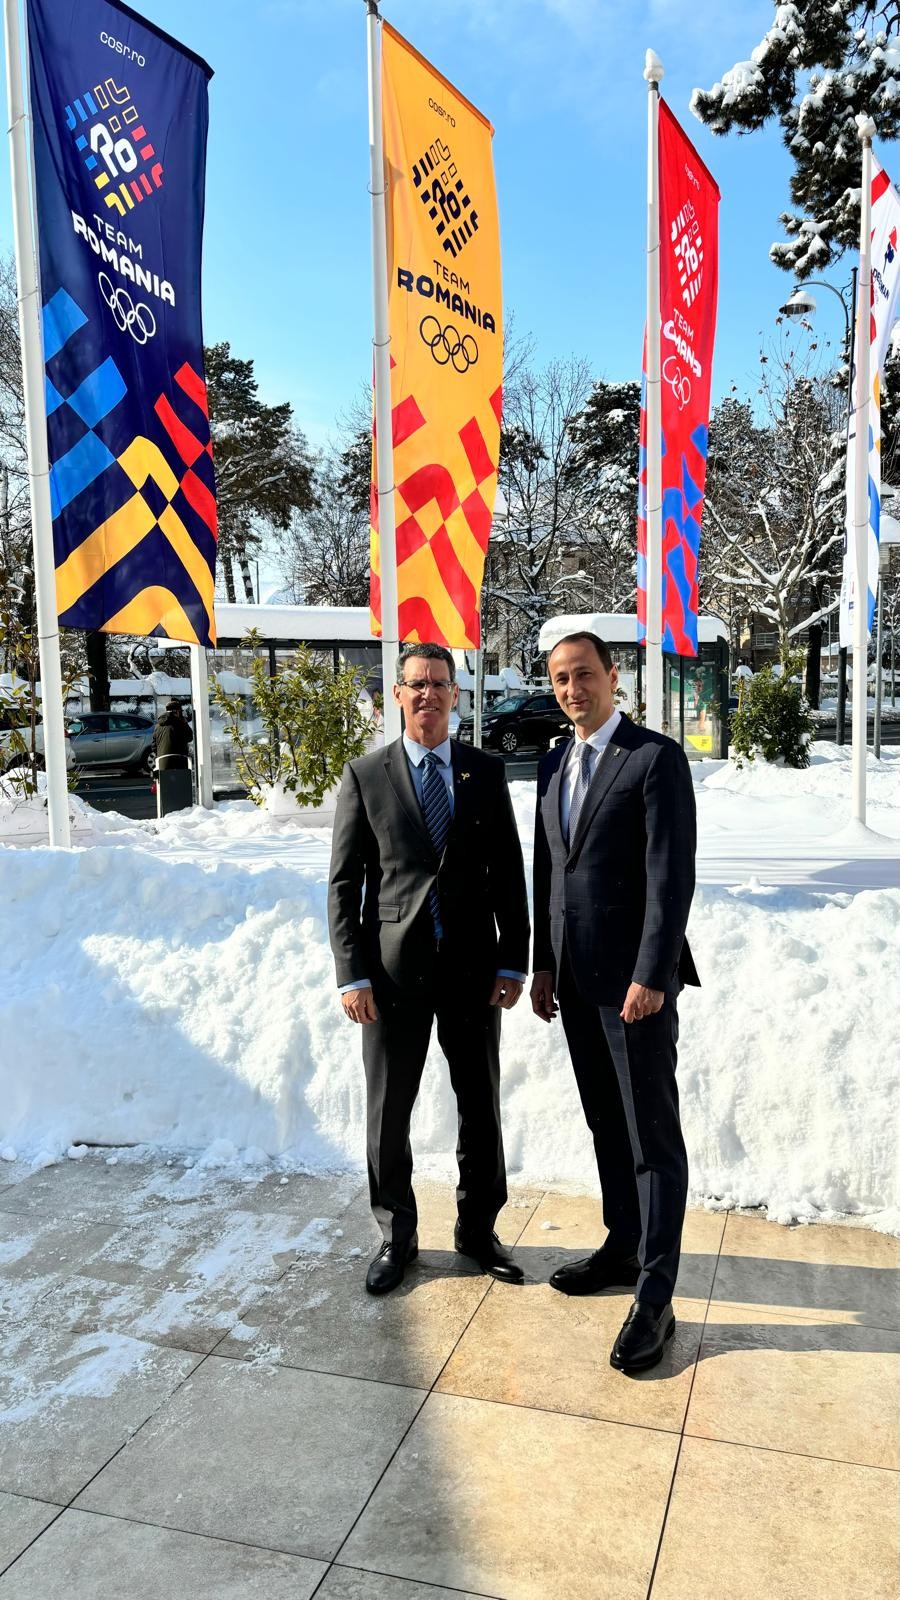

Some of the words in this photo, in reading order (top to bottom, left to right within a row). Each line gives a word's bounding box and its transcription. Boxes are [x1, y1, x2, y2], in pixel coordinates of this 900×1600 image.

[99, 31, 146, 67] cosr.ro
[428, 97, 456, 128] cosr.ro
[93, 214, 143, 259] TEAM
[71, 210, 176, 307] ROMANIA
[433, 259, 470, 294] TEAM
[397, 266, 496, 334] ROMANIA
[673, 308, 695, 342] TEAM
